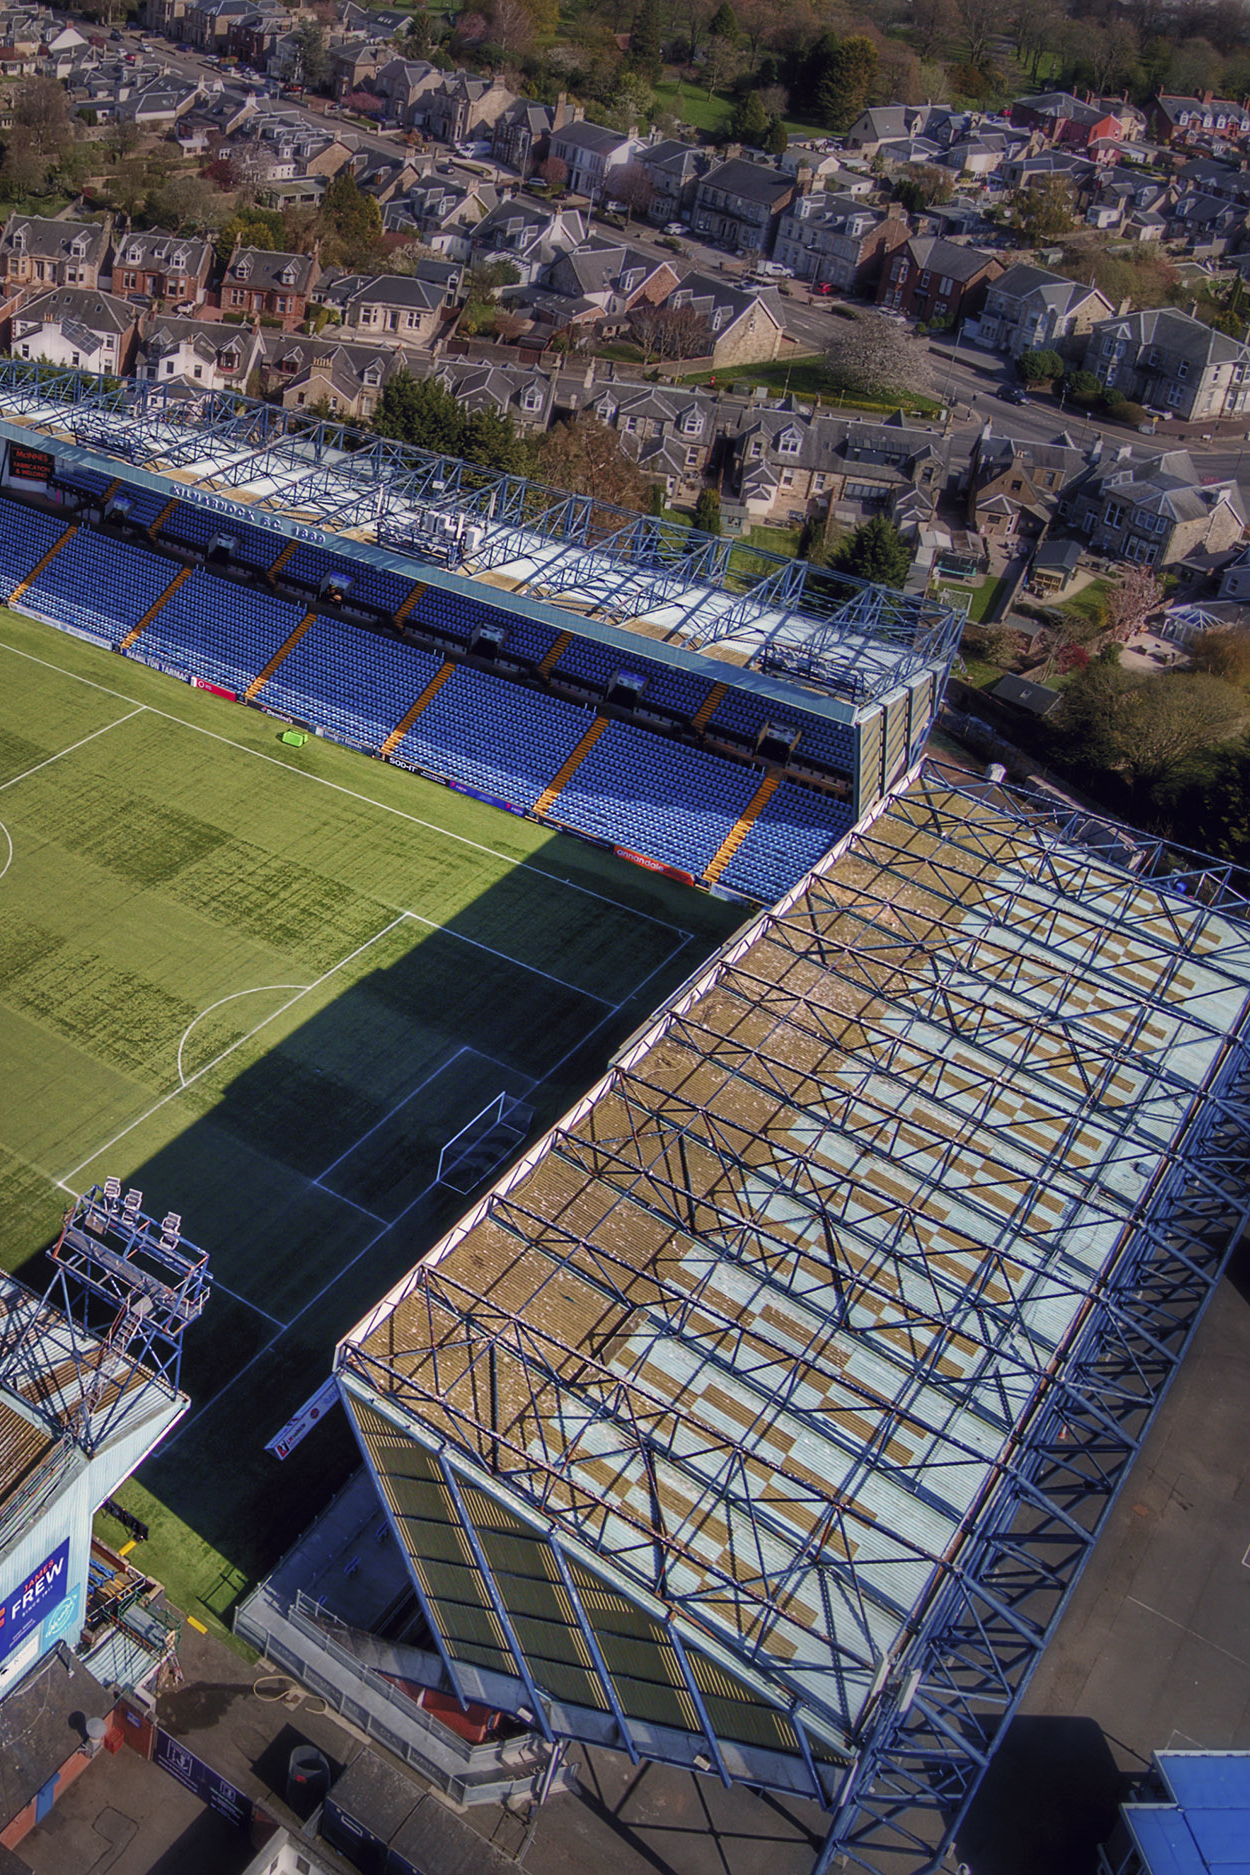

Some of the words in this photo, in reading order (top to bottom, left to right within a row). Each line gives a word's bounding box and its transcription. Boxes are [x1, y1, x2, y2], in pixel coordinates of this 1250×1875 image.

[13, 462, 50, 472] FABRICATION
[173, 485, 255, 521] KILMARNOCK
[262, 516, 284, 530] F.C.
[294, 526, 327, 544] 1869
[127, 648, 159, 671] HAMILTON
[161, 664, 189, 681] TARMAC
[266, 709, 293, 724] Domino's
[617, 848, 664, 872] annandale
[12, 1557, 64, 1620] FREW
[24, 1558, 54, 1593] JAMES
[22, 1598, 40, 1617] SINCE
